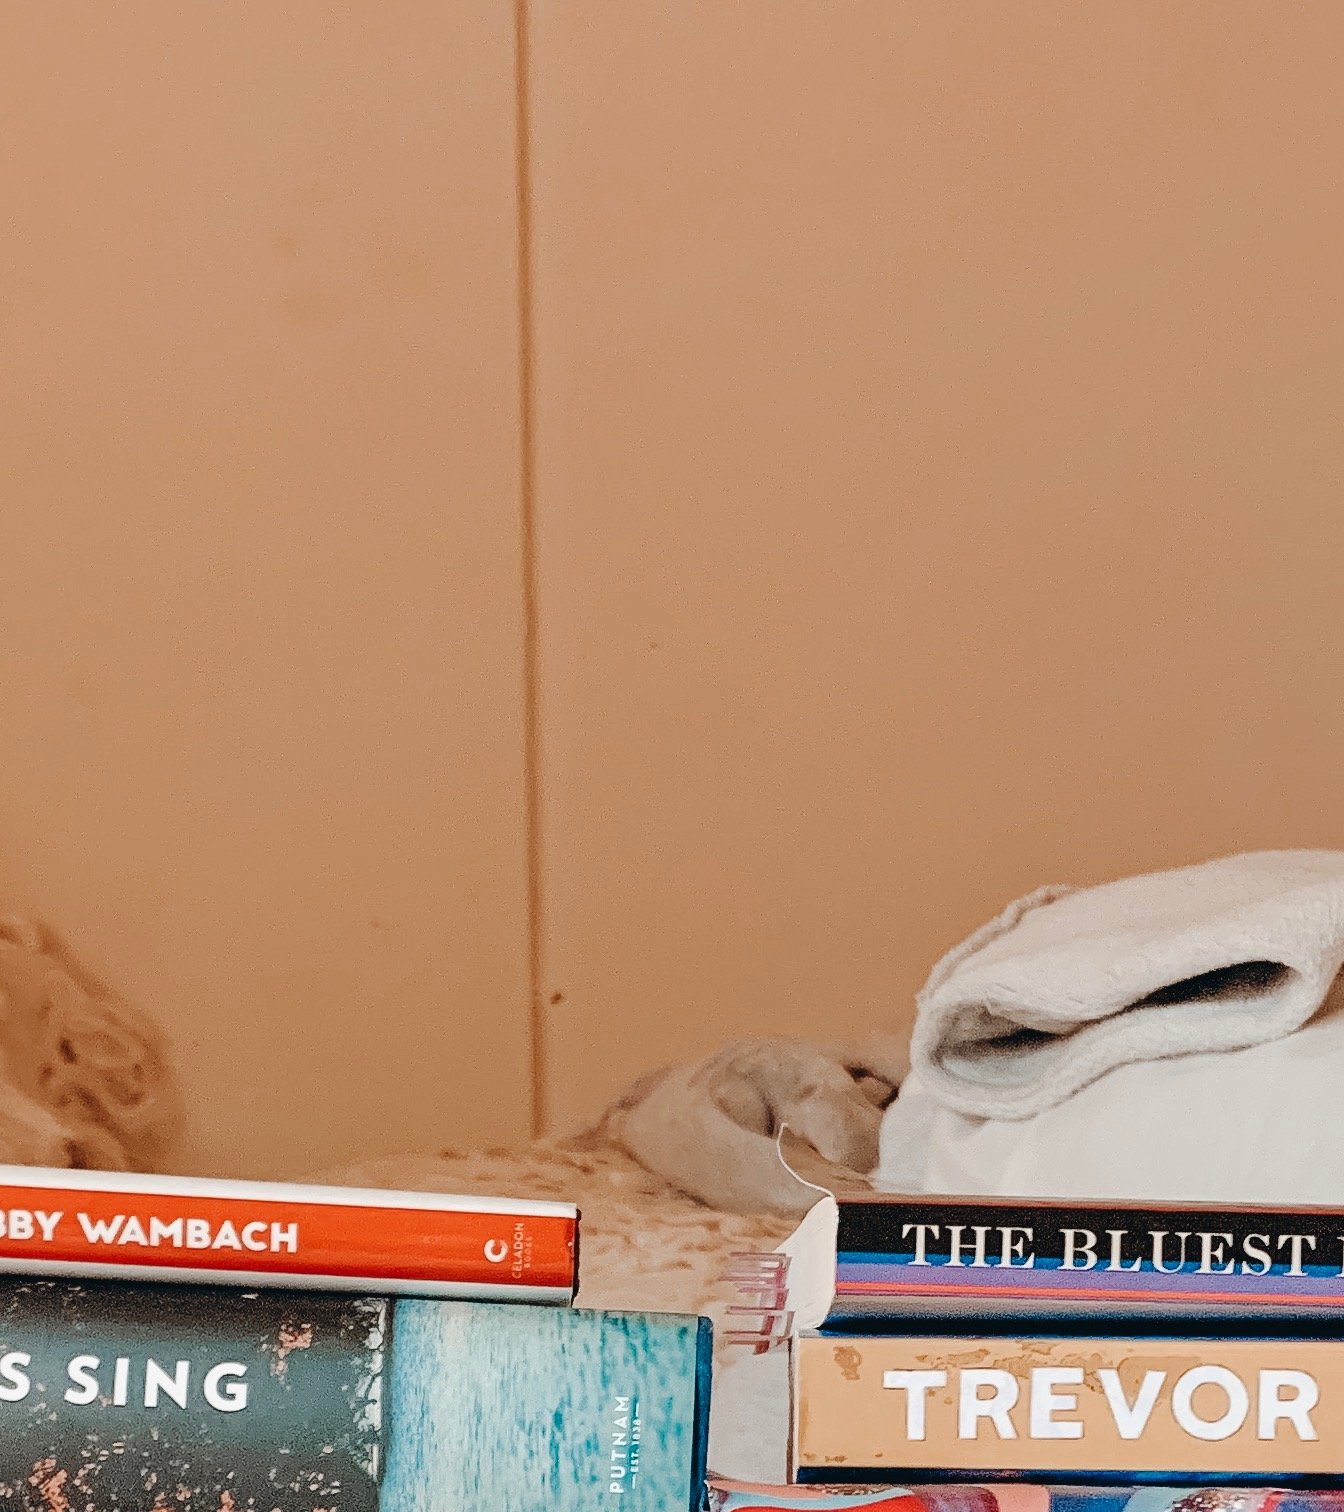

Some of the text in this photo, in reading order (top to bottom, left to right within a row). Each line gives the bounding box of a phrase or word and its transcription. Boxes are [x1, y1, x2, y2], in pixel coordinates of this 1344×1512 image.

[77, 1213, 297, 1253] WAMBACH
[512, 1223, 524, 1278] CELADON
[902, 1225, 1035, 1269] THE
[1058, 1228, 1317, 1277] BLUEST
[64, 1355, 249, 1413] SING
[883, 1366, 1319, 1442] TREVOR
[609, 1396, 629, 1494] PUTNAM
